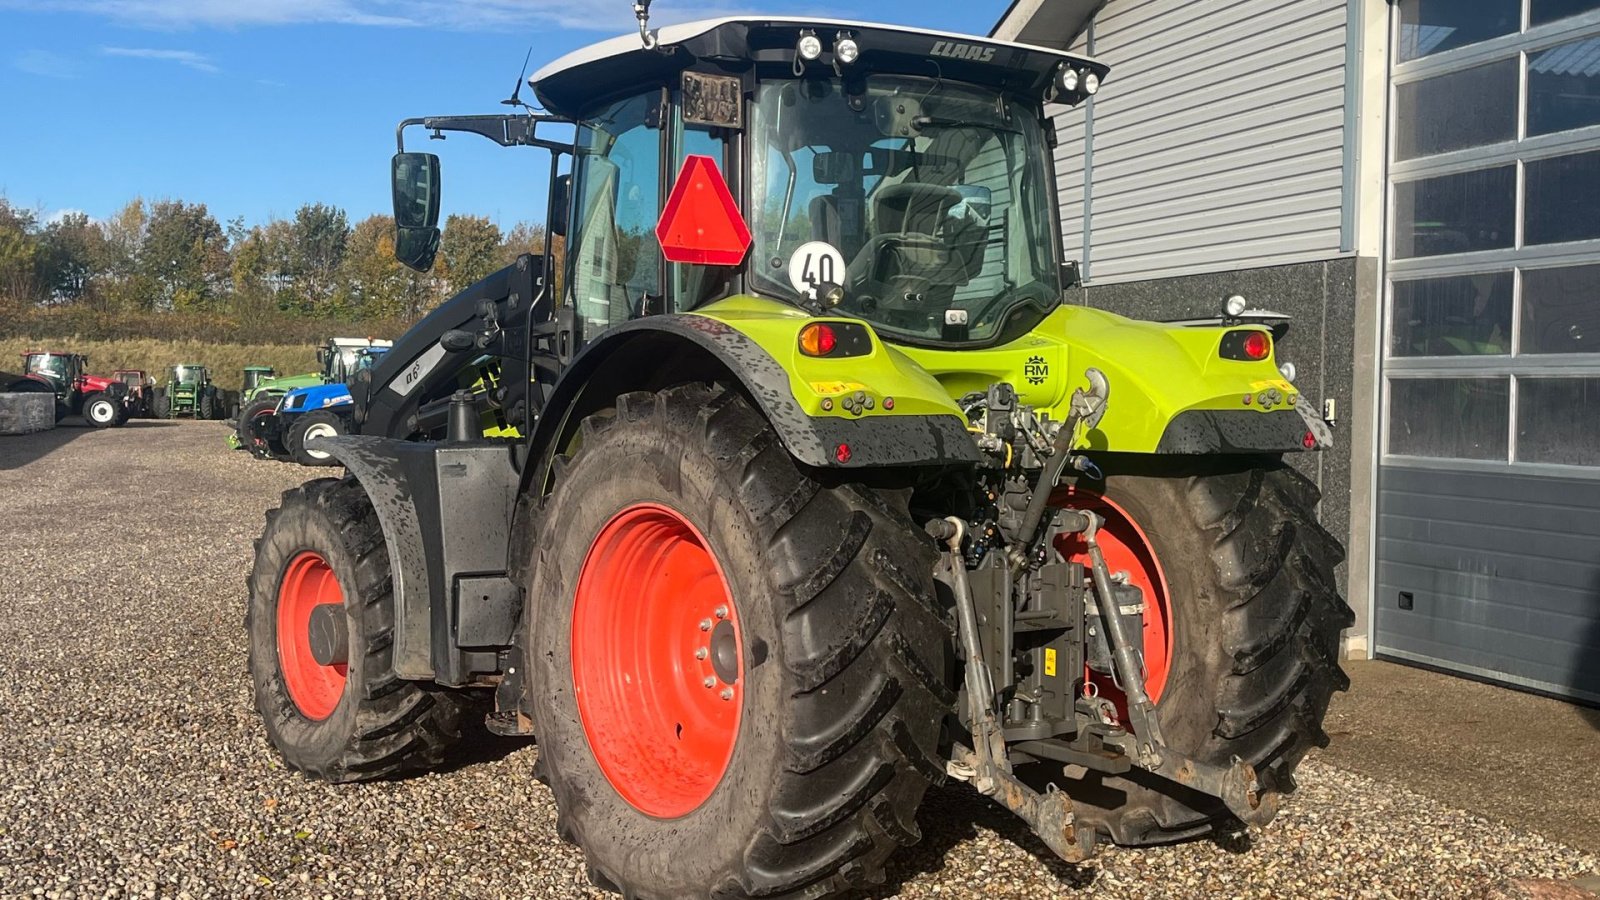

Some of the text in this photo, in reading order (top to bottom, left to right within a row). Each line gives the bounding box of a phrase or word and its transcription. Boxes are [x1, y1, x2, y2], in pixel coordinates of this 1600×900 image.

[930, 41, 996, 61] CLAAS
[802, 253, 834, 284] 40
[1024, 365, 1049, 376] RM
